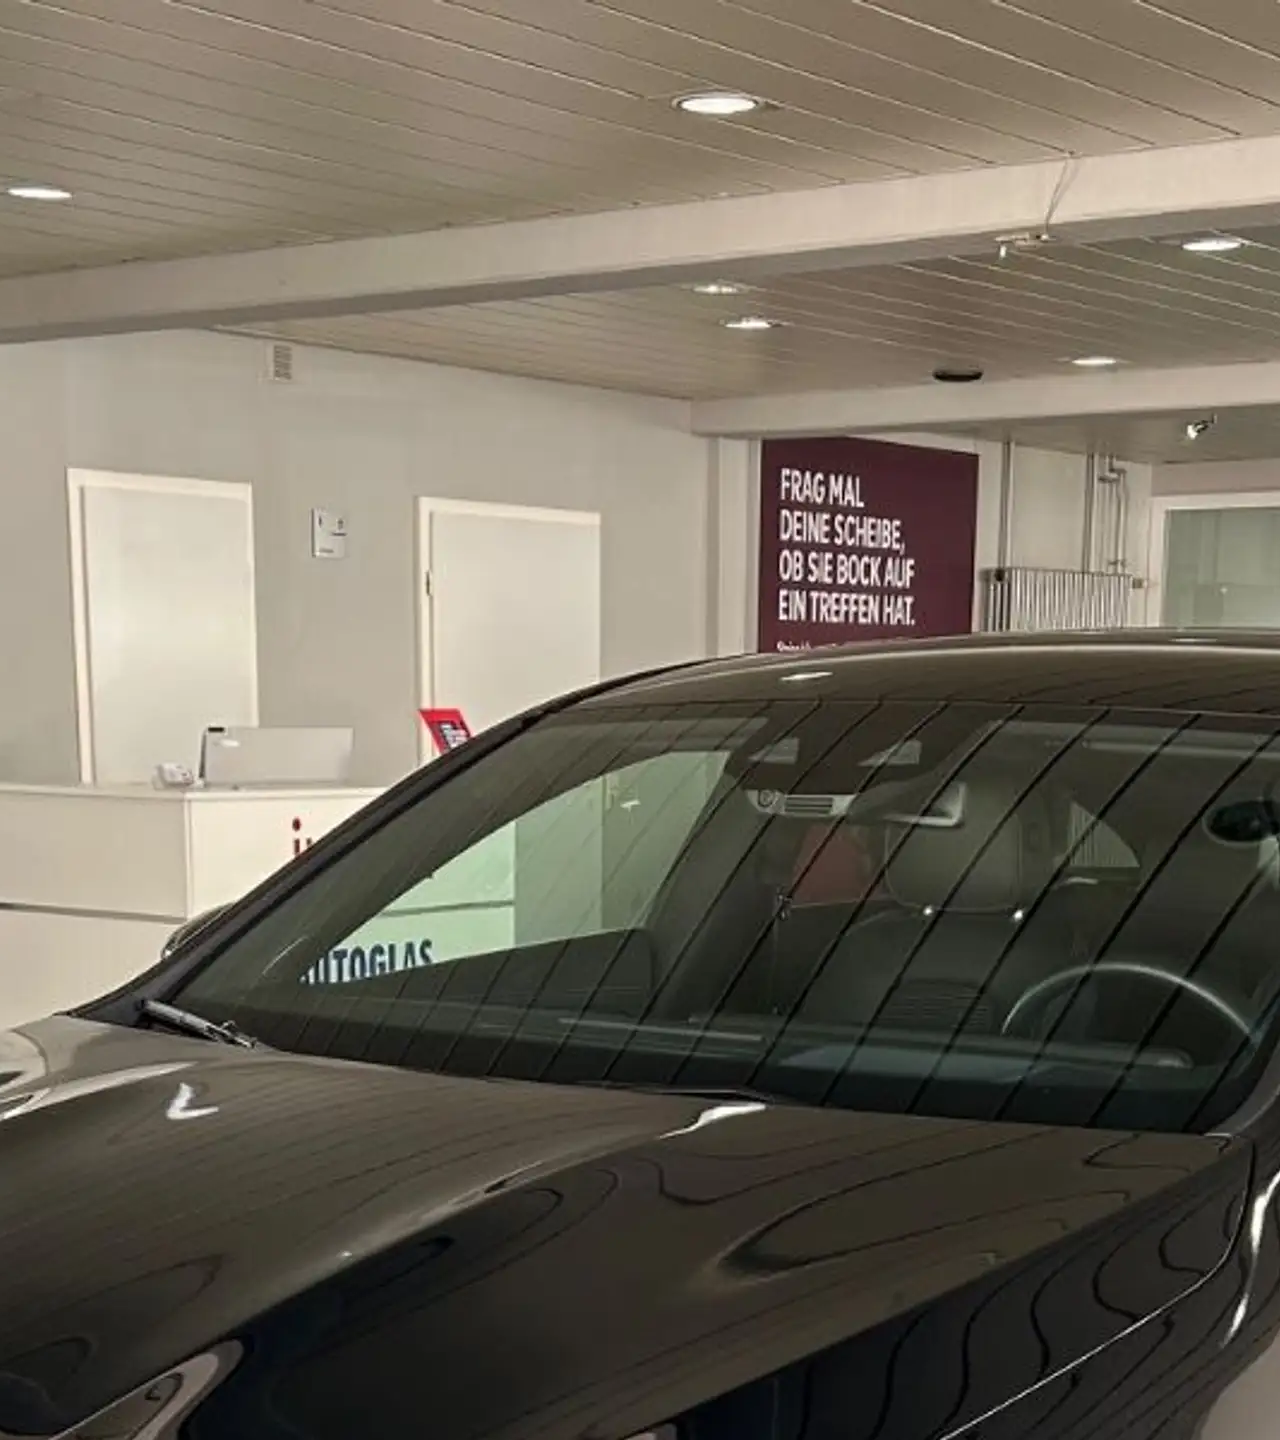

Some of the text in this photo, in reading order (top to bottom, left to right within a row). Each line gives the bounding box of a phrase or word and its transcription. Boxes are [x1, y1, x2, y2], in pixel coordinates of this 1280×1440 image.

[781, 467, 865, 508] FRAG MAL
[780, 508, 905, 555] DEINE SCHEIBE,
[779, 549, 916, 589] OB SIE BOCK AUF
[778, 588, 917, 626] EIN TREFFEN HAT.
